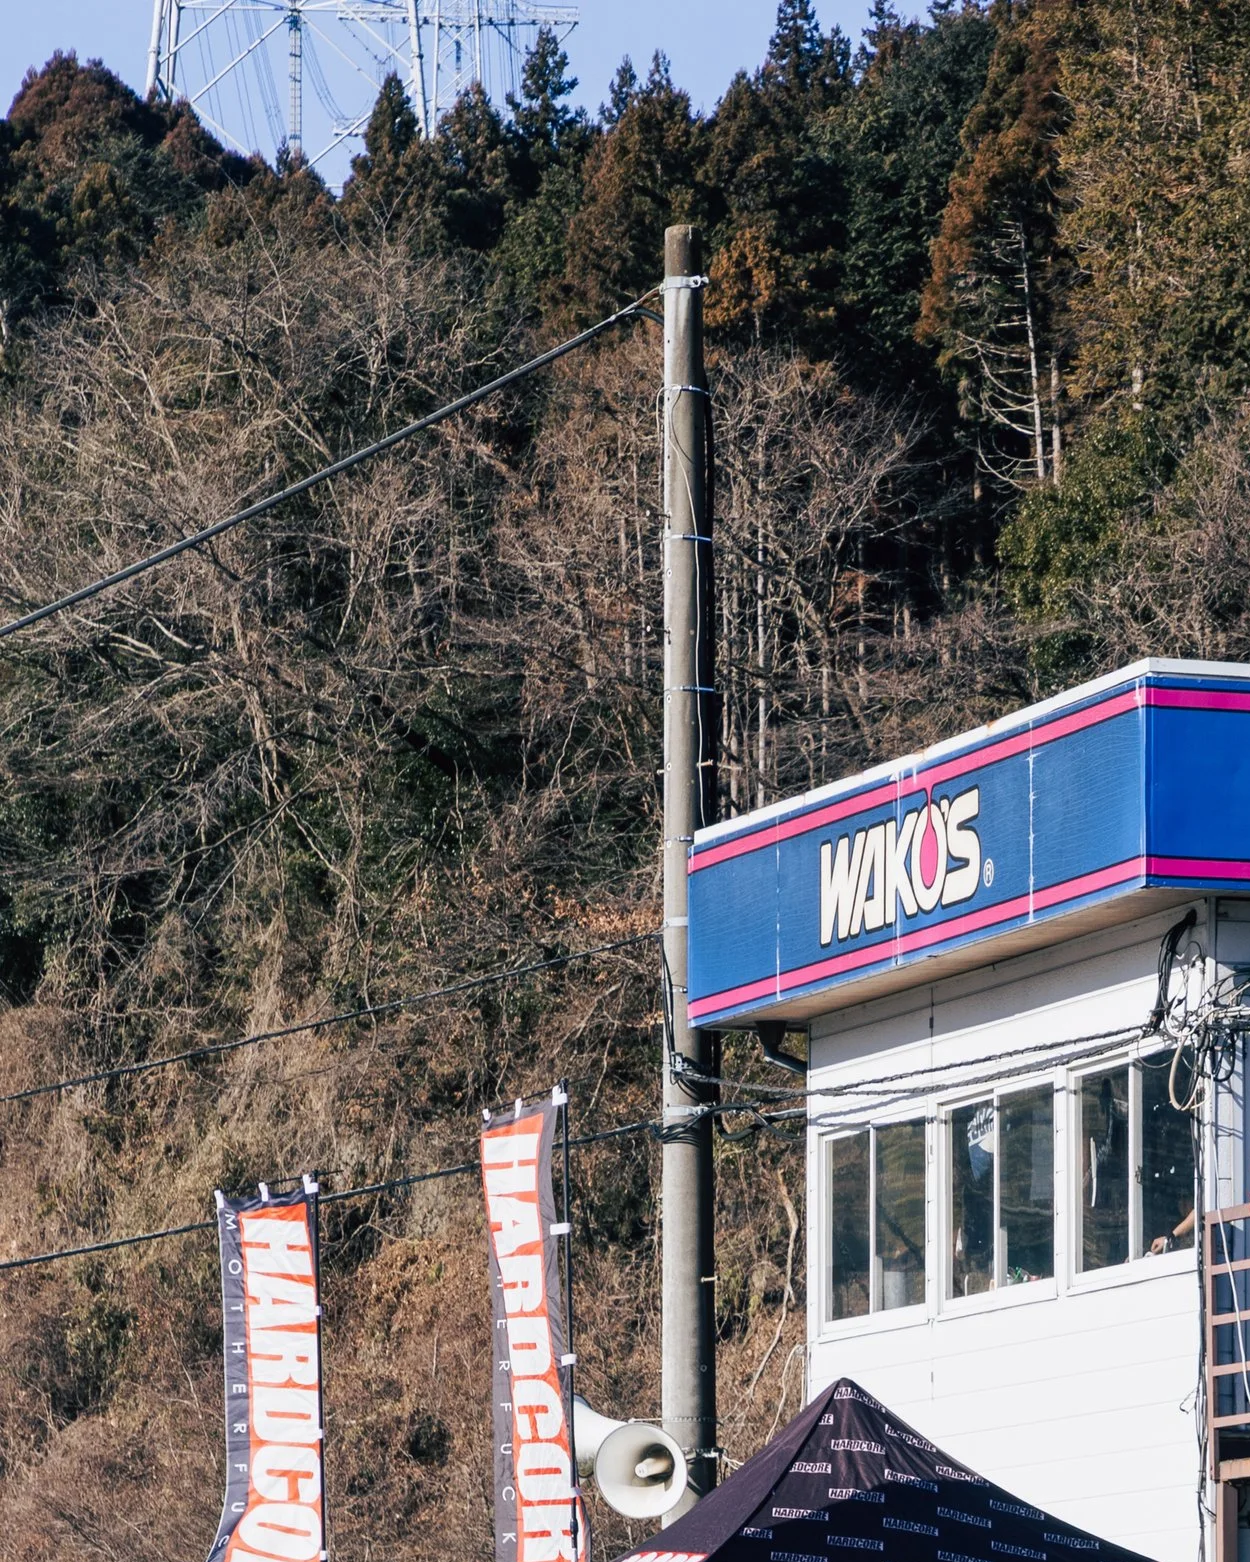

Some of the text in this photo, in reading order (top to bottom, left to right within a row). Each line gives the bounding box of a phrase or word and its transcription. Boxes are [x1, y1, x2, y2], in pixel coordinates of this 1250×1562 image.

[819, 785, 981, 947] WAKO'S
[831, 1439, 885, 1455] HARDCORE
[829, 1488, 885, 1503] HARDCORE
[772, 1507, 829, 1522] HARDCORE
[938, 1506, 992, 1529] HARDCORE
[883, 1517, 939, 1537] HARDCORE
[827, 1535, 884, 1551] HARDCORE
[992, 1541, 1047, 1561] HARDCORE
